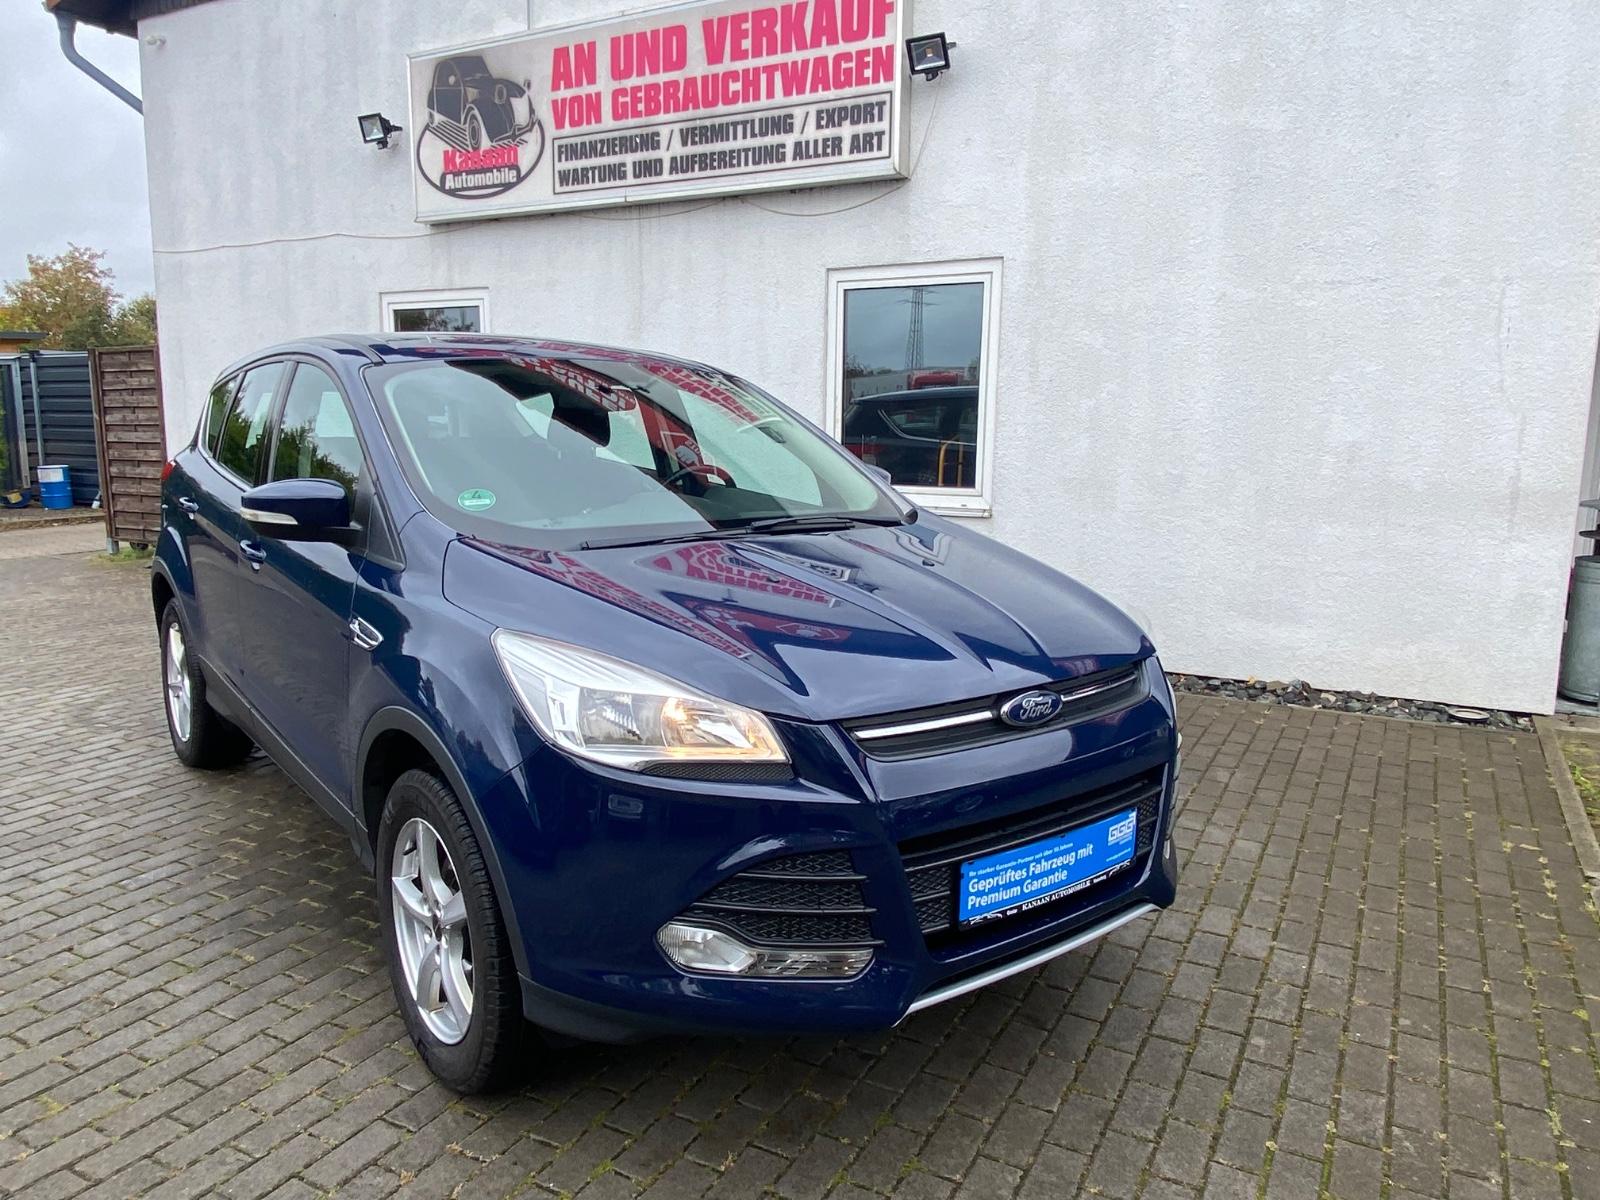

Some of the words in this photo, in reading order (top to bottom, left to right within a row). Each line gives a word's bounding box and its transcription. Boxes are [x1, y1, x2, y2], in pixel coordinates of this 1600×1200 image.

[551, 41, 597, 92] AN
[610, 24, 688, 82] UND
[702, 0, 895, 66] VERKAUF
[551, 92, 602, 131] VON
[611, 44, 895, 122] GEBRAUCHTWAGEN
[557, 131, 661, 163] FINANZIERUNG
[680, 113, 794, 148] VERMITTLUNG
[815, 101, 887, 130] EXPORT
[444, 168, 518, 190] Automobile
[557, 162, 628, 187] WARTUNG
[632, 158, 664, 180] UND
[669, 143, 786, 176] AUFBEREITUNG
[792, 136, 843, 161] ALLER
[850, 130, 886, 155] ART
[1020, 695, 1057, 720] Ford
[967, 885, 1021, 910] Premium
[1022, 867, 1068, 894] Garantie
[968, 867, 1028, 893] Geprüftes
[1029, 851, 1076, 877] Fahrzeug
[1077, 842, 1094, 860] mit
[1022, 895, 1051, 911] KANAAN
[1051, 880, 1091, 901] AUTOMOBILE
